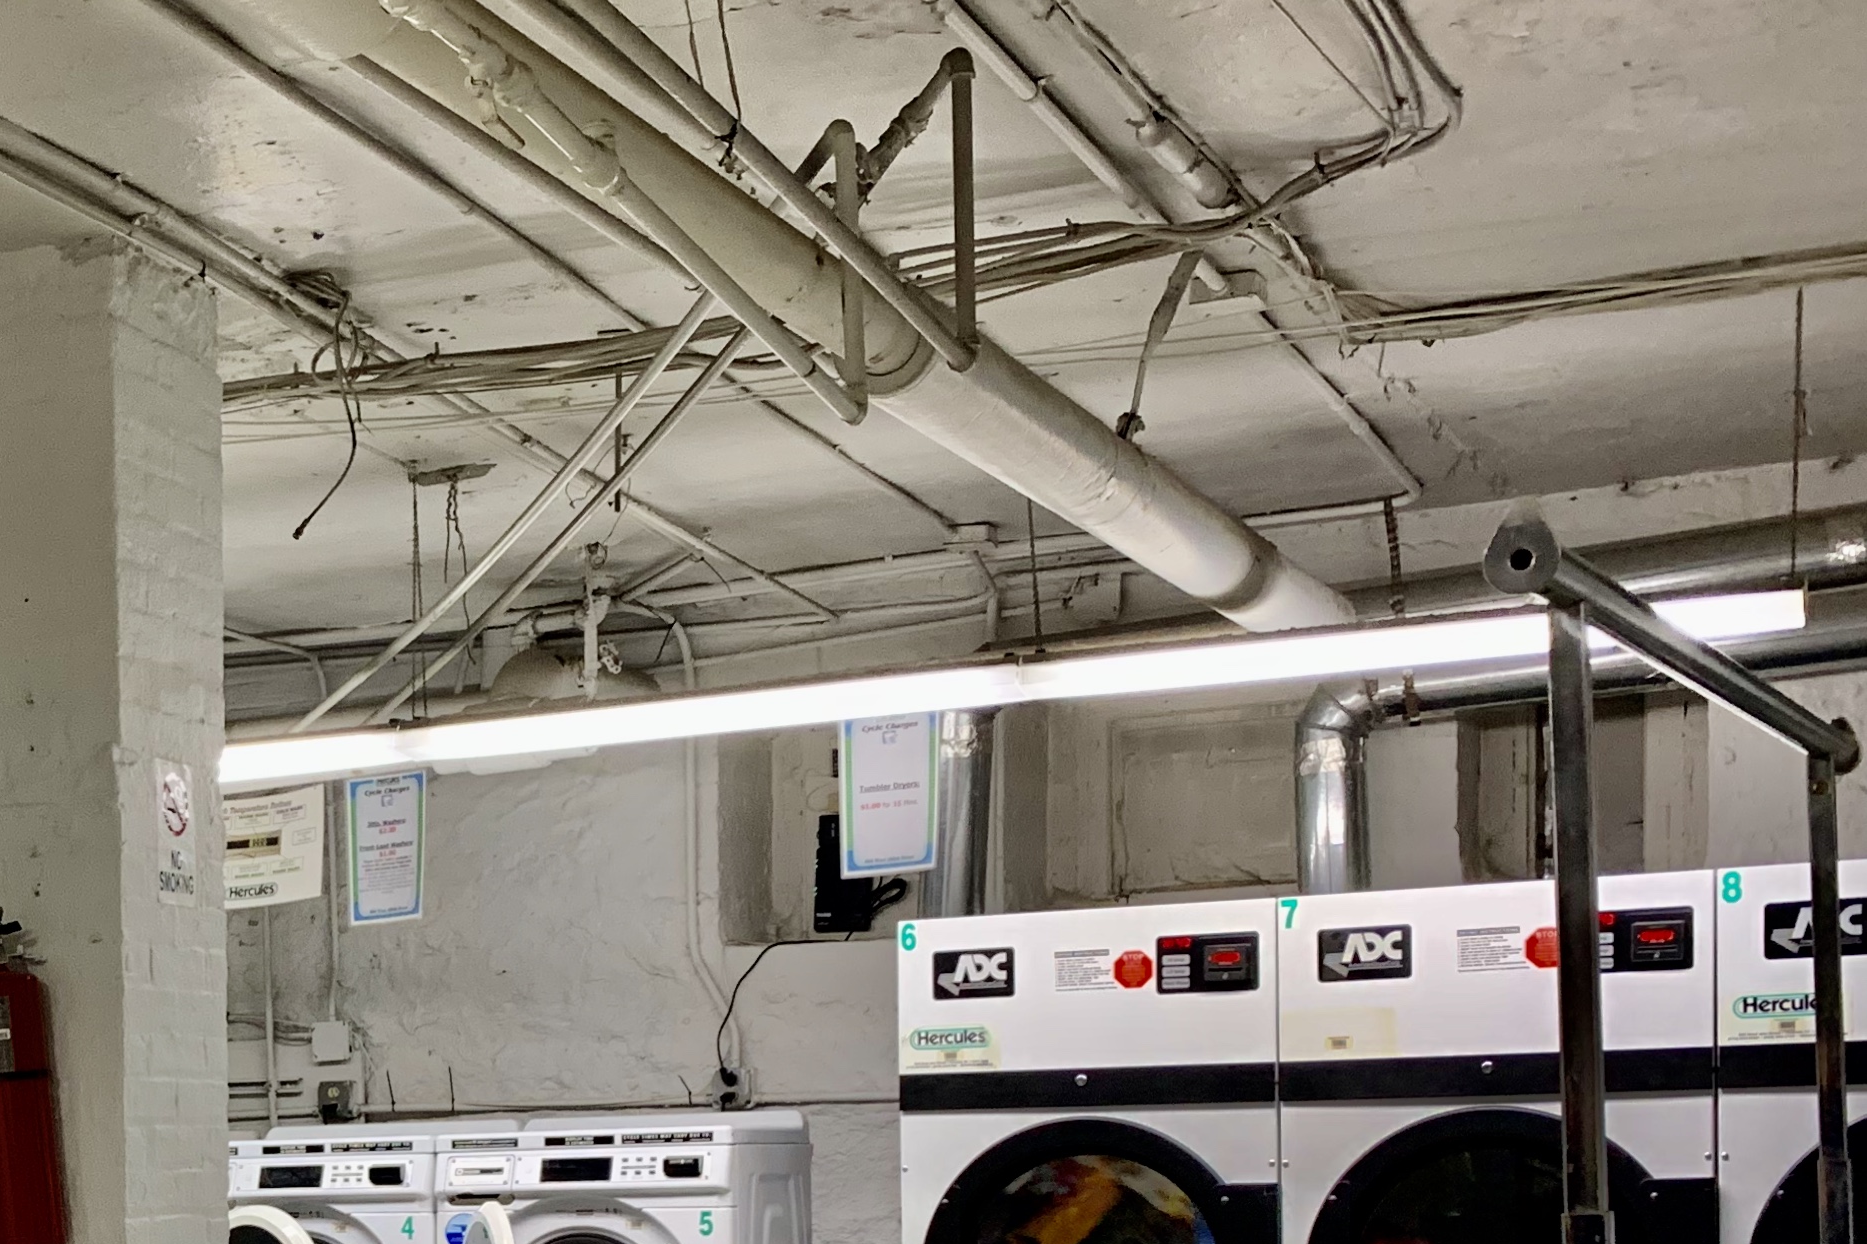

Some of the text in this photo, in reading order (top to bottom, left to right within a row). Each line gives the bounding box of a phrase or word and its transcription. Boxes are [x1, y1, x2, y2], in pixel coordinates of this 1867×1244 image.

[886, 721, 918, 730] Charges
[859, 784, 891, 793] Tumbler
[171, 850, 182, 870] NO
[160, 871, 194, 895] SMOKING
[229, 884, 274, 898] Hercules
[1722, 871, 1742, 903] 8
[1281, 899, 1298, 929] 7
[1792, 904, 1863, 939] AC
[901, 923, 917, 951] 6
[1341, 930, 1404, 963] ADC
[953, 952, 1008, 983] ADC
[917, 1029, 986, 1046] Hercules
[401, 1216, 415, 1240] 4
[699, 1211, 713, 1236] 5
